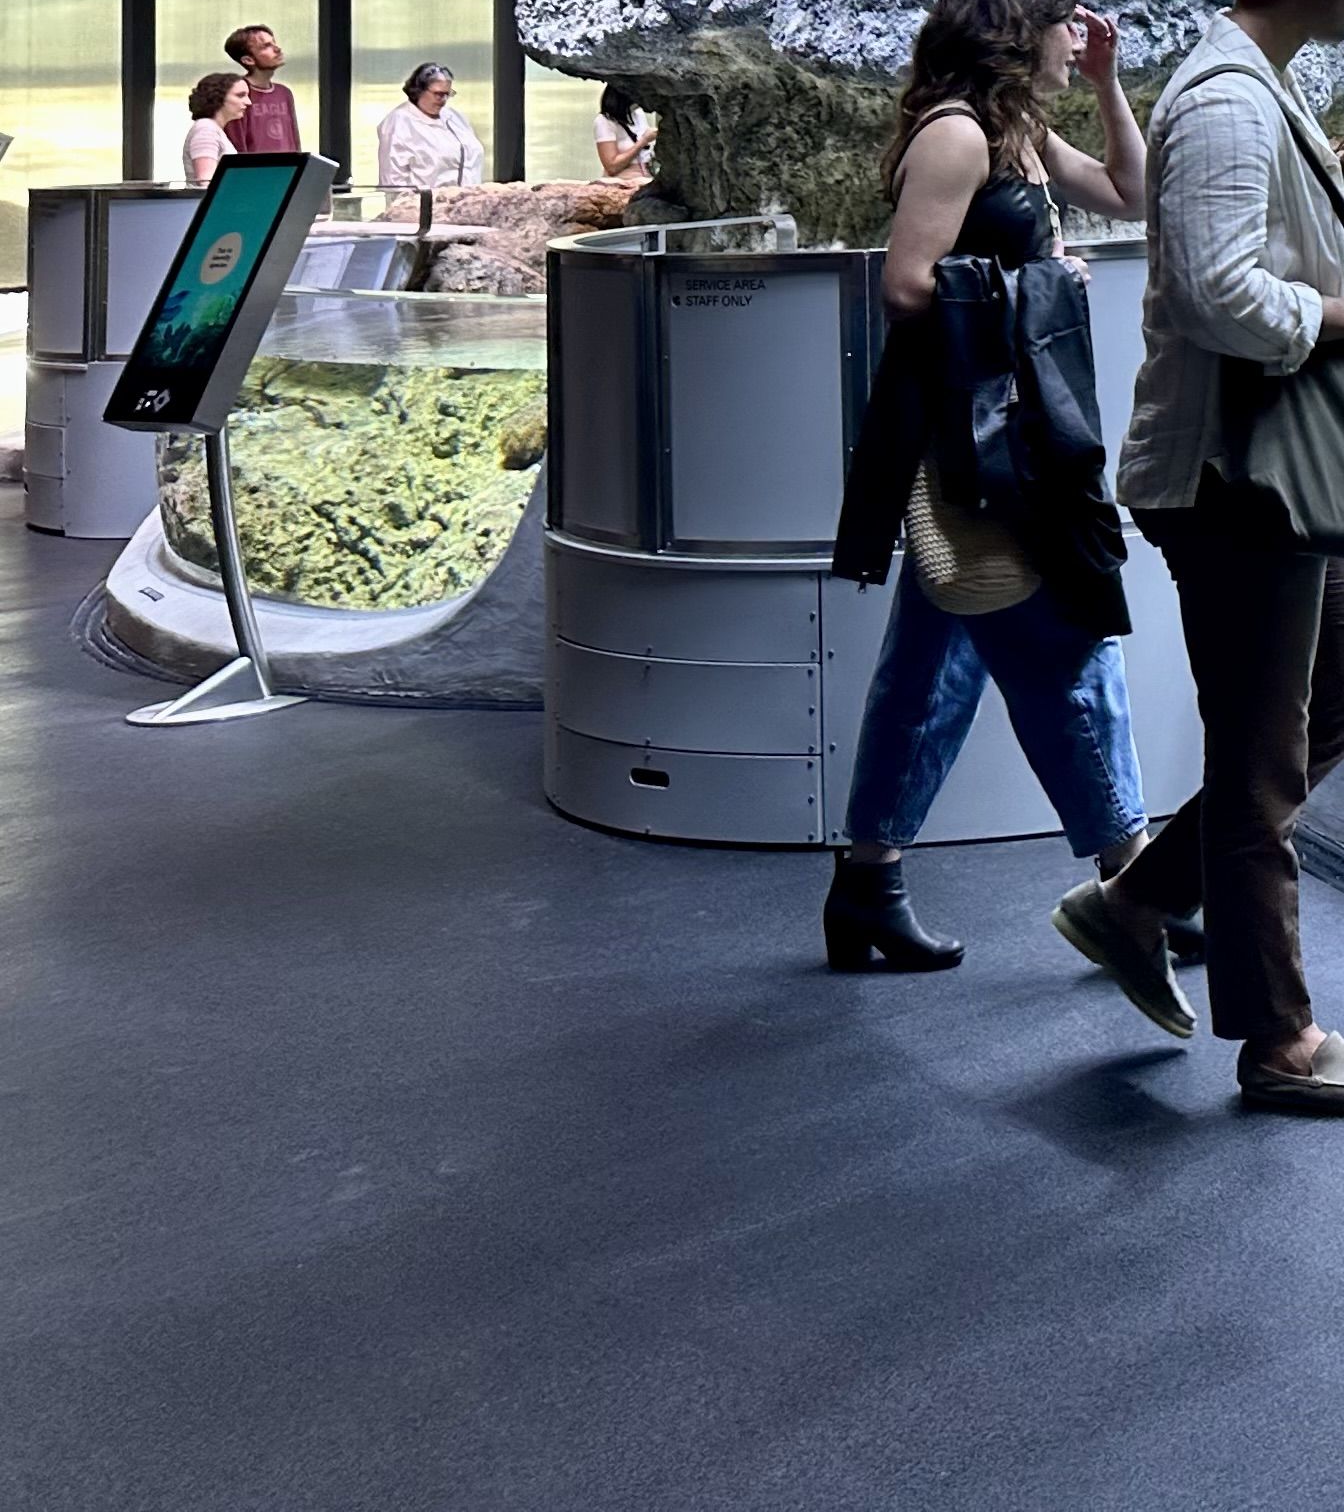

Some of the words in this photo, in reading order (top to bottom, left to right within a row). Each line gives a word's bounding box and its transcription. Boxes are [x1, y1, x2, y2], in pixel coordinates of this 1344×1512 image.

[686, 279, 731, 291] SERVICE
[734, 279, 766, 291] AREA
[686, 295, 720, 307] STAFF
[721, 295, 753, 307] ONLY
